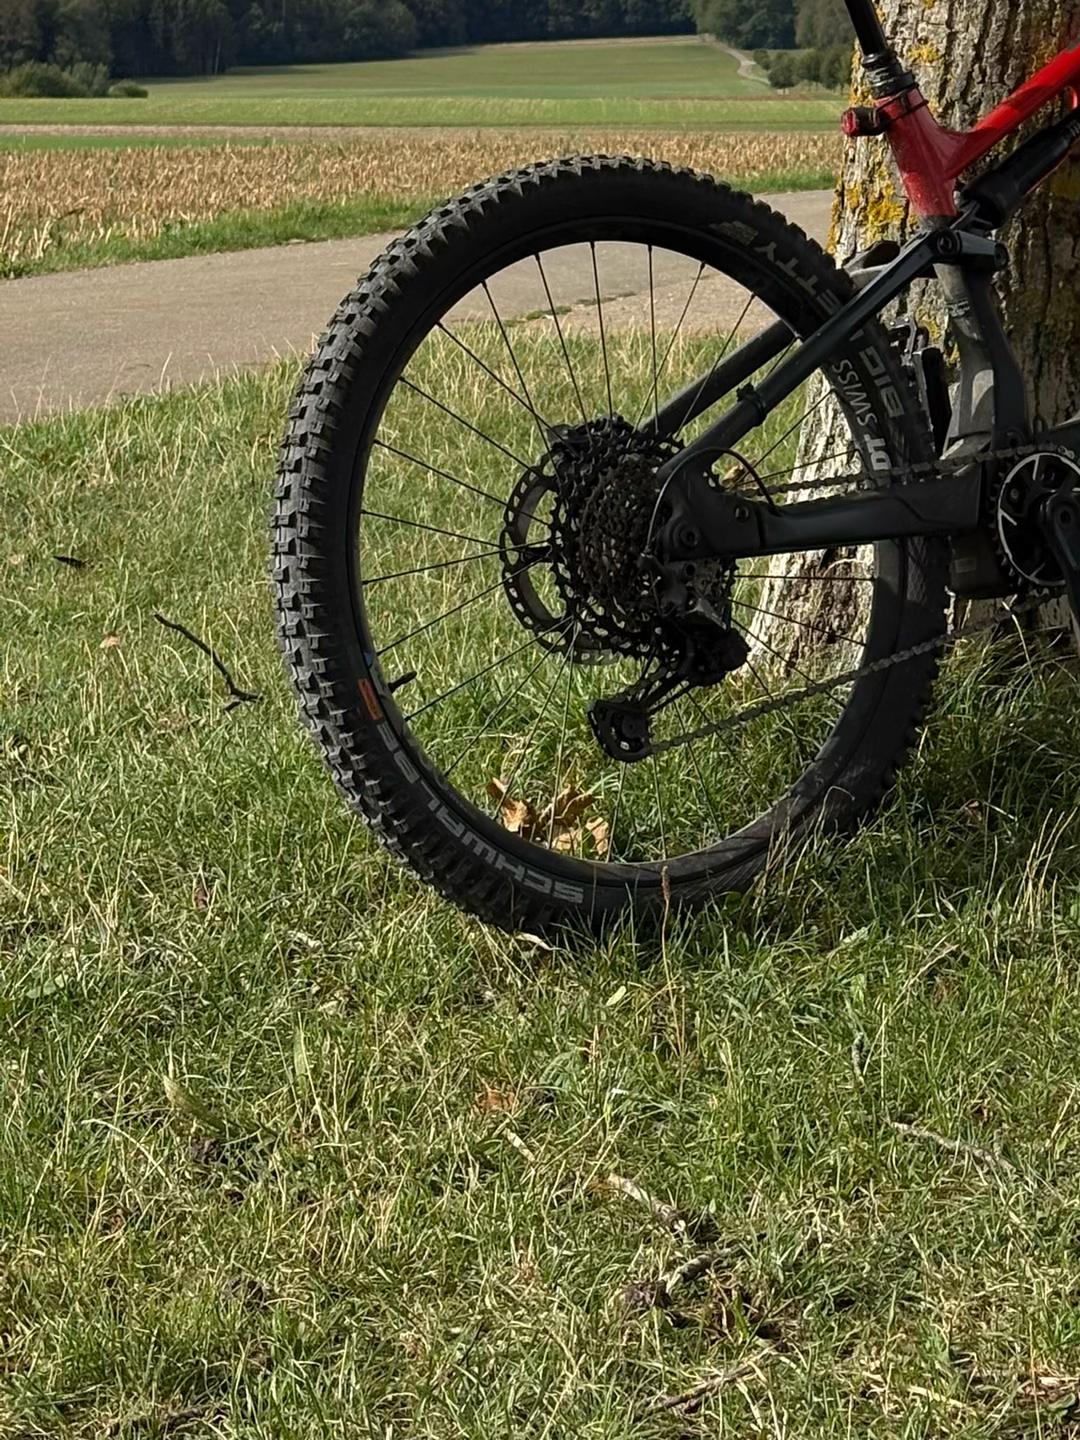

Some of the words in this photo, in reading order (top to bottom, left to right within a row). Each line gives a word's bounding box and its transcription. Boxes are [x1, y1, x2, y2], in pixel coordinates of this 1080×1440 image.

[755, 242, 864, 341] ETTY
[832, 360, 877, 427] SWISS
[860, 347, 905, 418] BIG
[865, 434, 892, 471] DT
[376, 723, 584, 904] SCHWALBE
